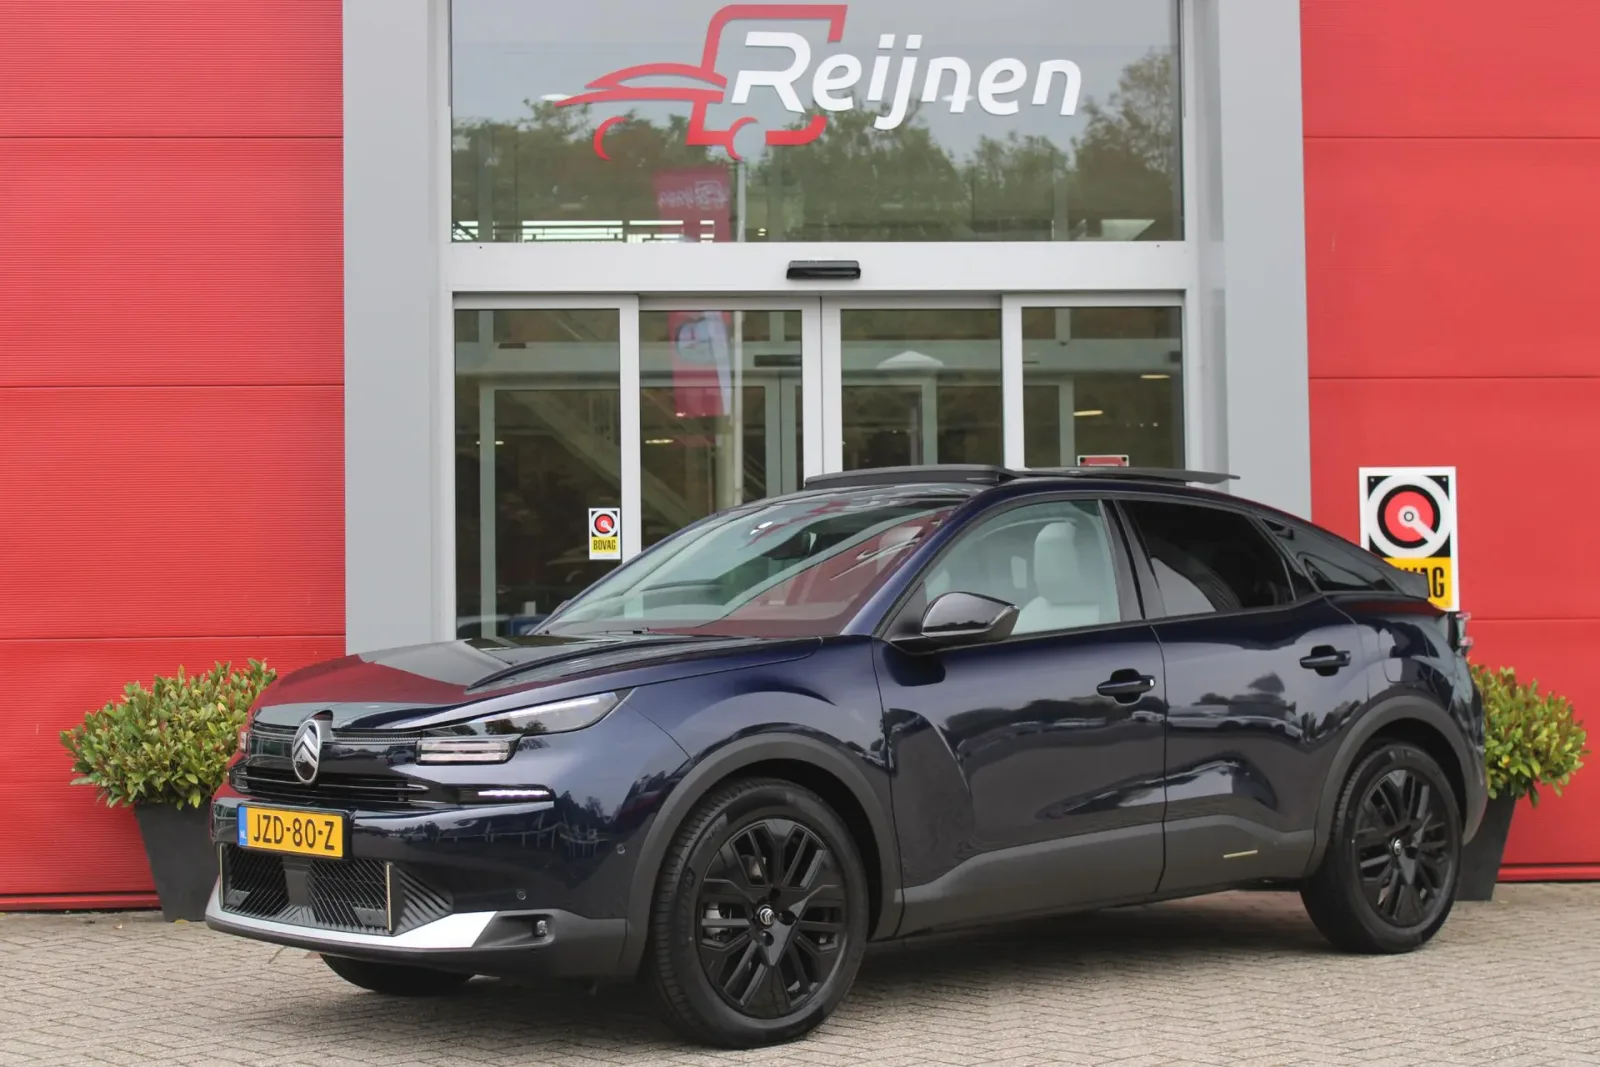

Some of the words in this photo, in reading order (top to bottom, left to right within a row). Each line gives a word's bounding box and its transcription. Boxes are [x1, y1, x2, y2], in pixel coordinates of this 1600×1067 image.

[731, 31, 1082, 130] Reijnen
[593, 539, 616, 551] BOVAG
[253, 814, 335, 850] JZD-80-Z
